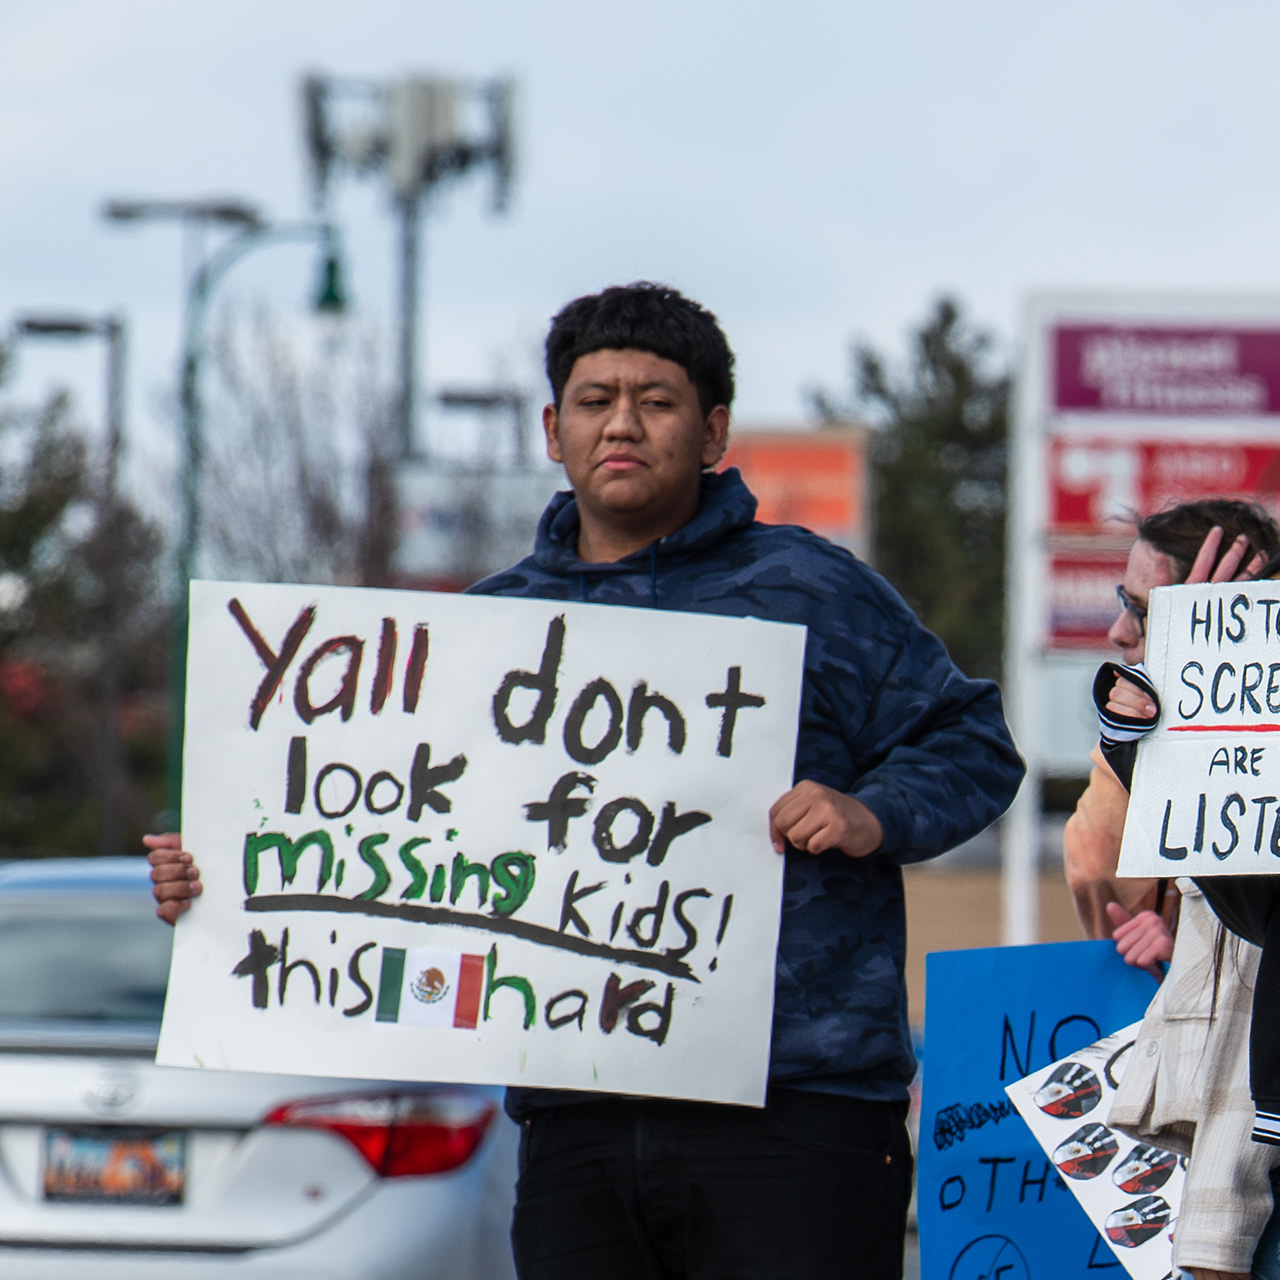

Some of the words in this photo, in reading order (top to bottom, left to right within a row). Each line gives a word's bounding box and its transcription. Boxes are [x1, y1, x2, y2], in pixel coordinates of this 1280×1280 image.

[228, 597, 430, 731] Yall
[492, 613, 766, 766] dont
[283, 735, 468, 823] look
[523, 770, 713, 867] for
[1208, 744, 1266, 778] ARE
[243, 822, 536, 916] missing
[231, 926, 377, 1018] this
[482, 942, 676, 1046] hard
